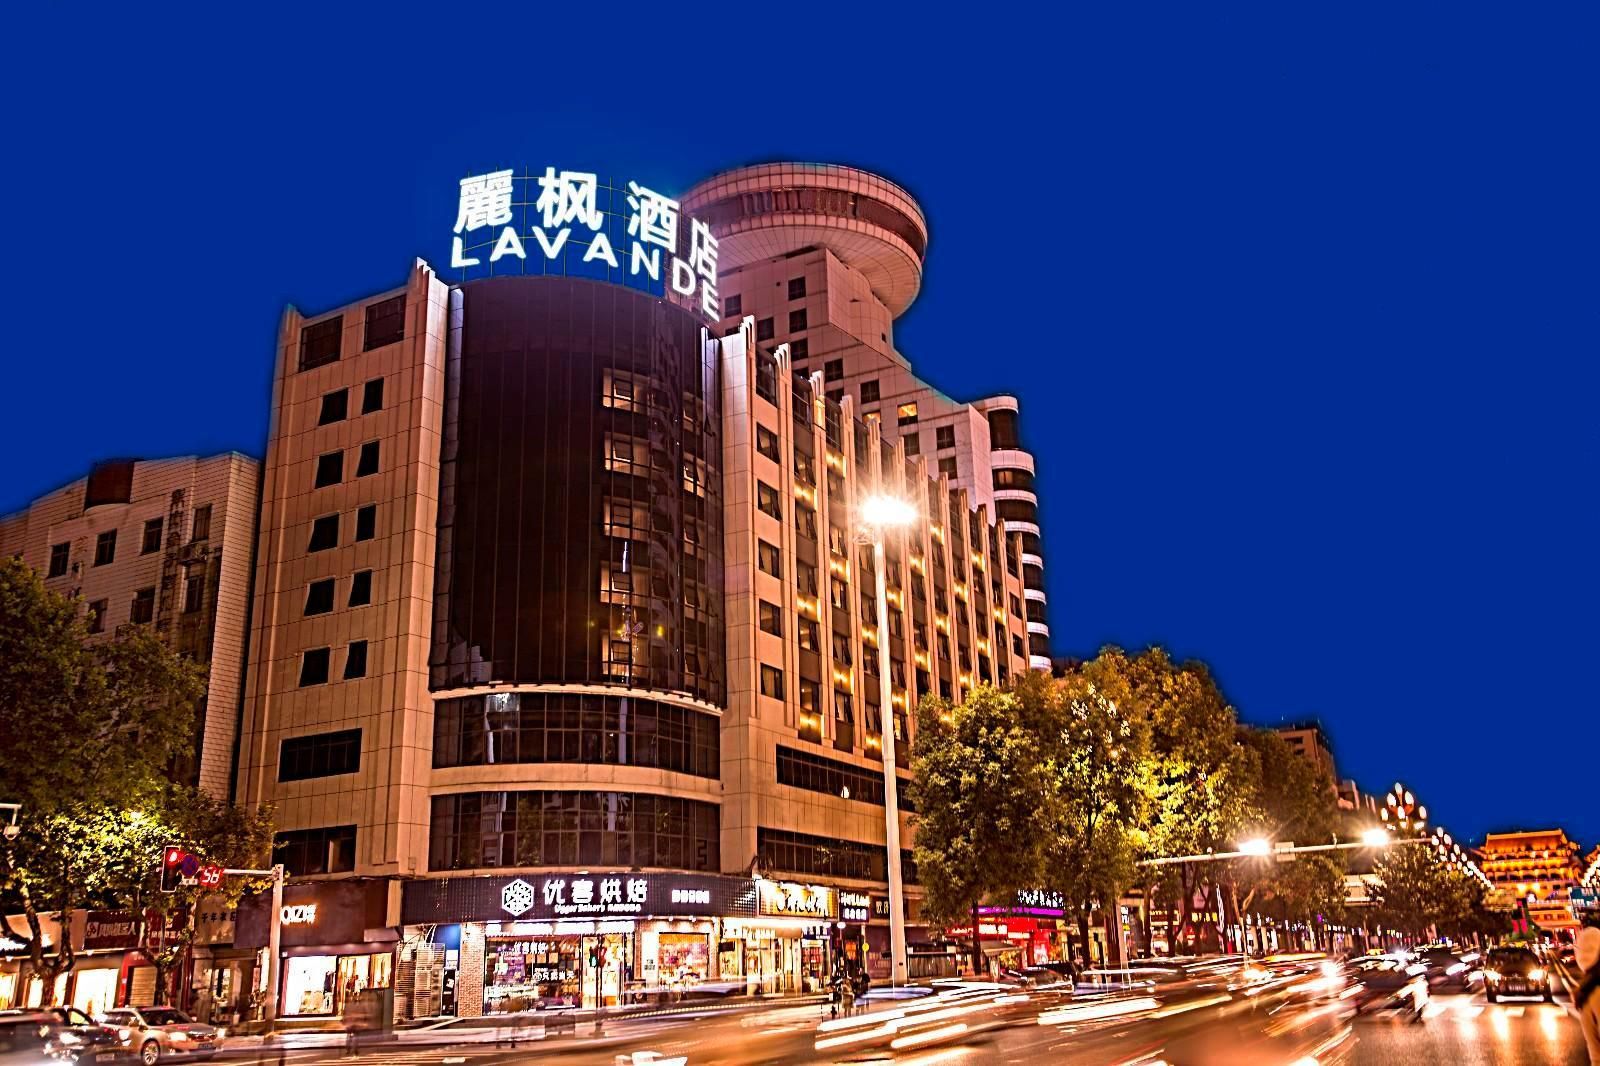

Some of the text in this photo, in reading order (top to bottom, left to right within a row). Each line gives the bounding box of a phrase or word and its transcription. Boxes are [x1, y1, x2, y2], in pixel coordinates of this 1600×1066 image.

[451, 226, 720, 322] LAVANDE
[453, 167, 718, 286] 麗枫酒店
